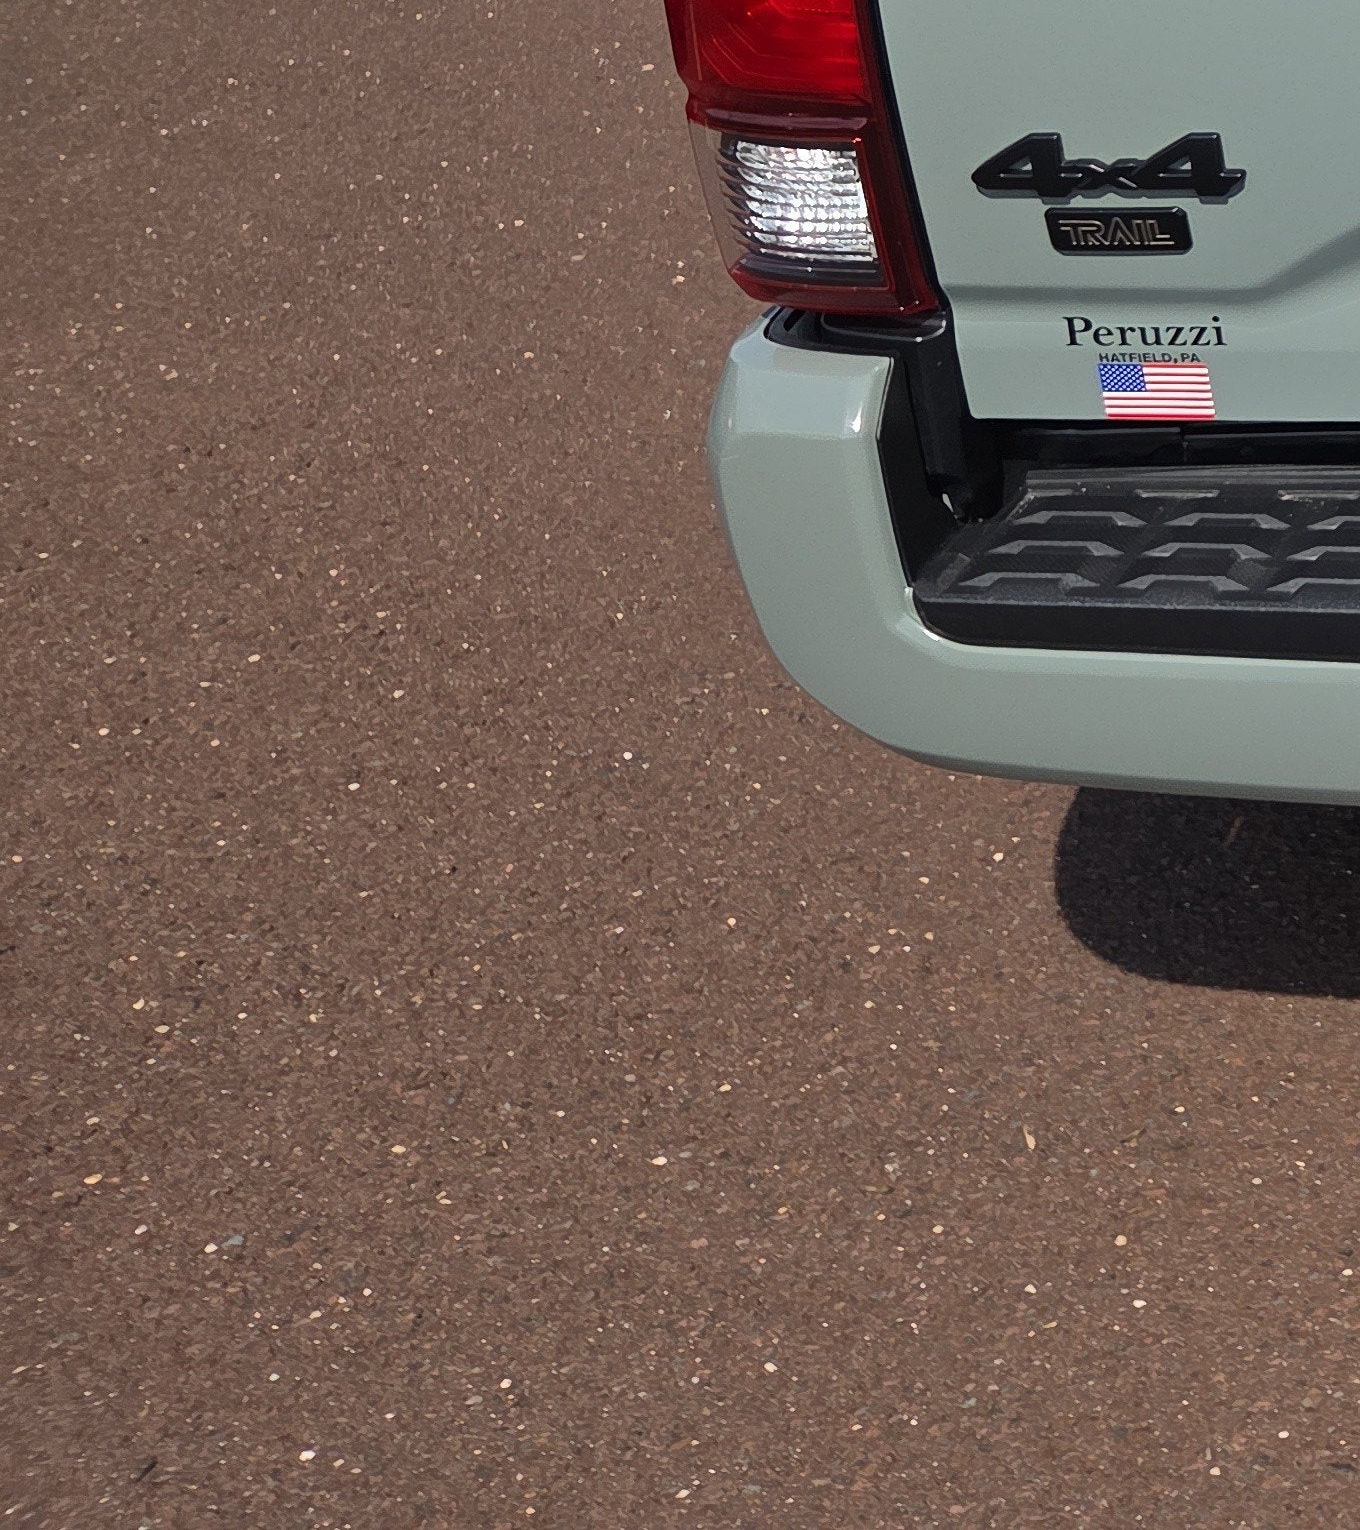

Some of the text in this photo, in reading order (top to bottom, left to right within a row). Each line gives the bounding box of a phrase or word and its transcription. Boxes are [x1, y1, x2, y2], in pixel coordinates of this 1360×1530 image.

[971, 132, 1246, 200] 4x4
[1058, 217, 1174, 246] TRAIL
[1062, 315, 1228, 346] Peruzzi
